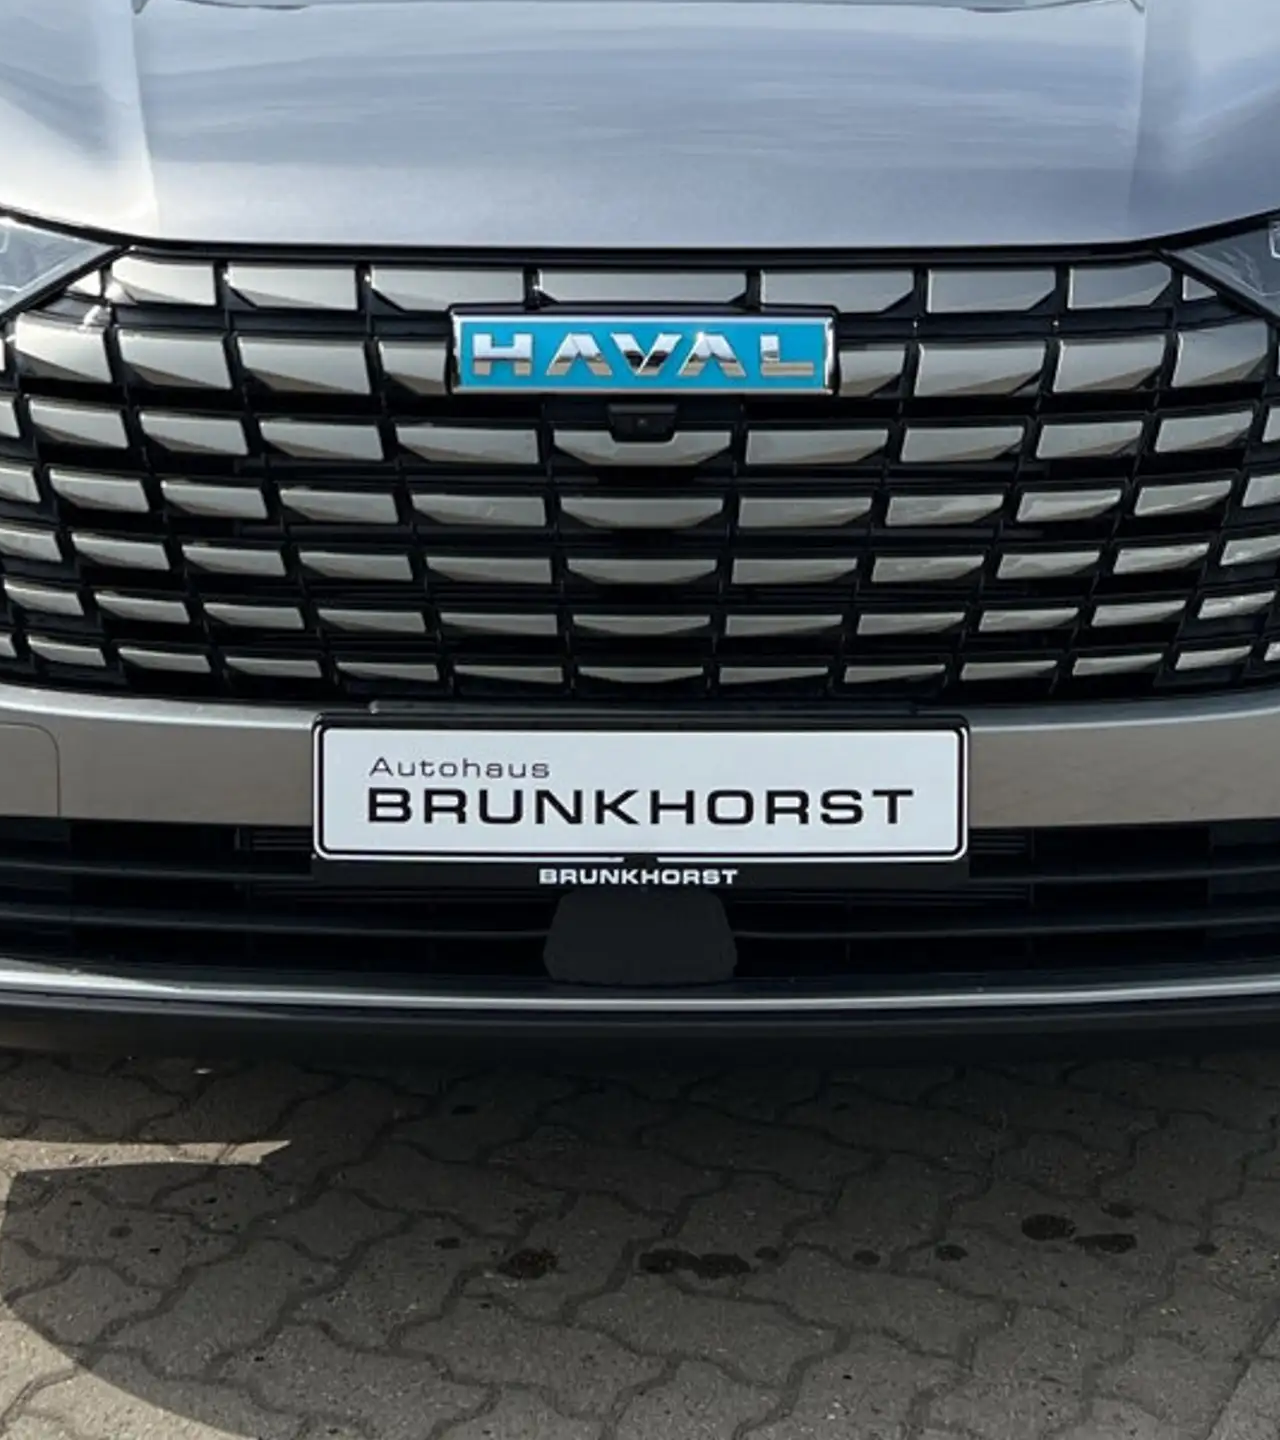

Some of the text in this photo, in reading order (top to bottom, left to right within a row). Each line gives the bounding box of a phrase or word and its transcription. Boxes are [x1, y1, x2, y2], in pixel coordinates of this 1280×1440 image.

[472, 332, 815, 378] HAVAL
[369, 756, 551, 779] Autohaus
[367, 787, 915, 826] BRUNKHORST
[538, 868, 739, 886] BRUNKHORST
